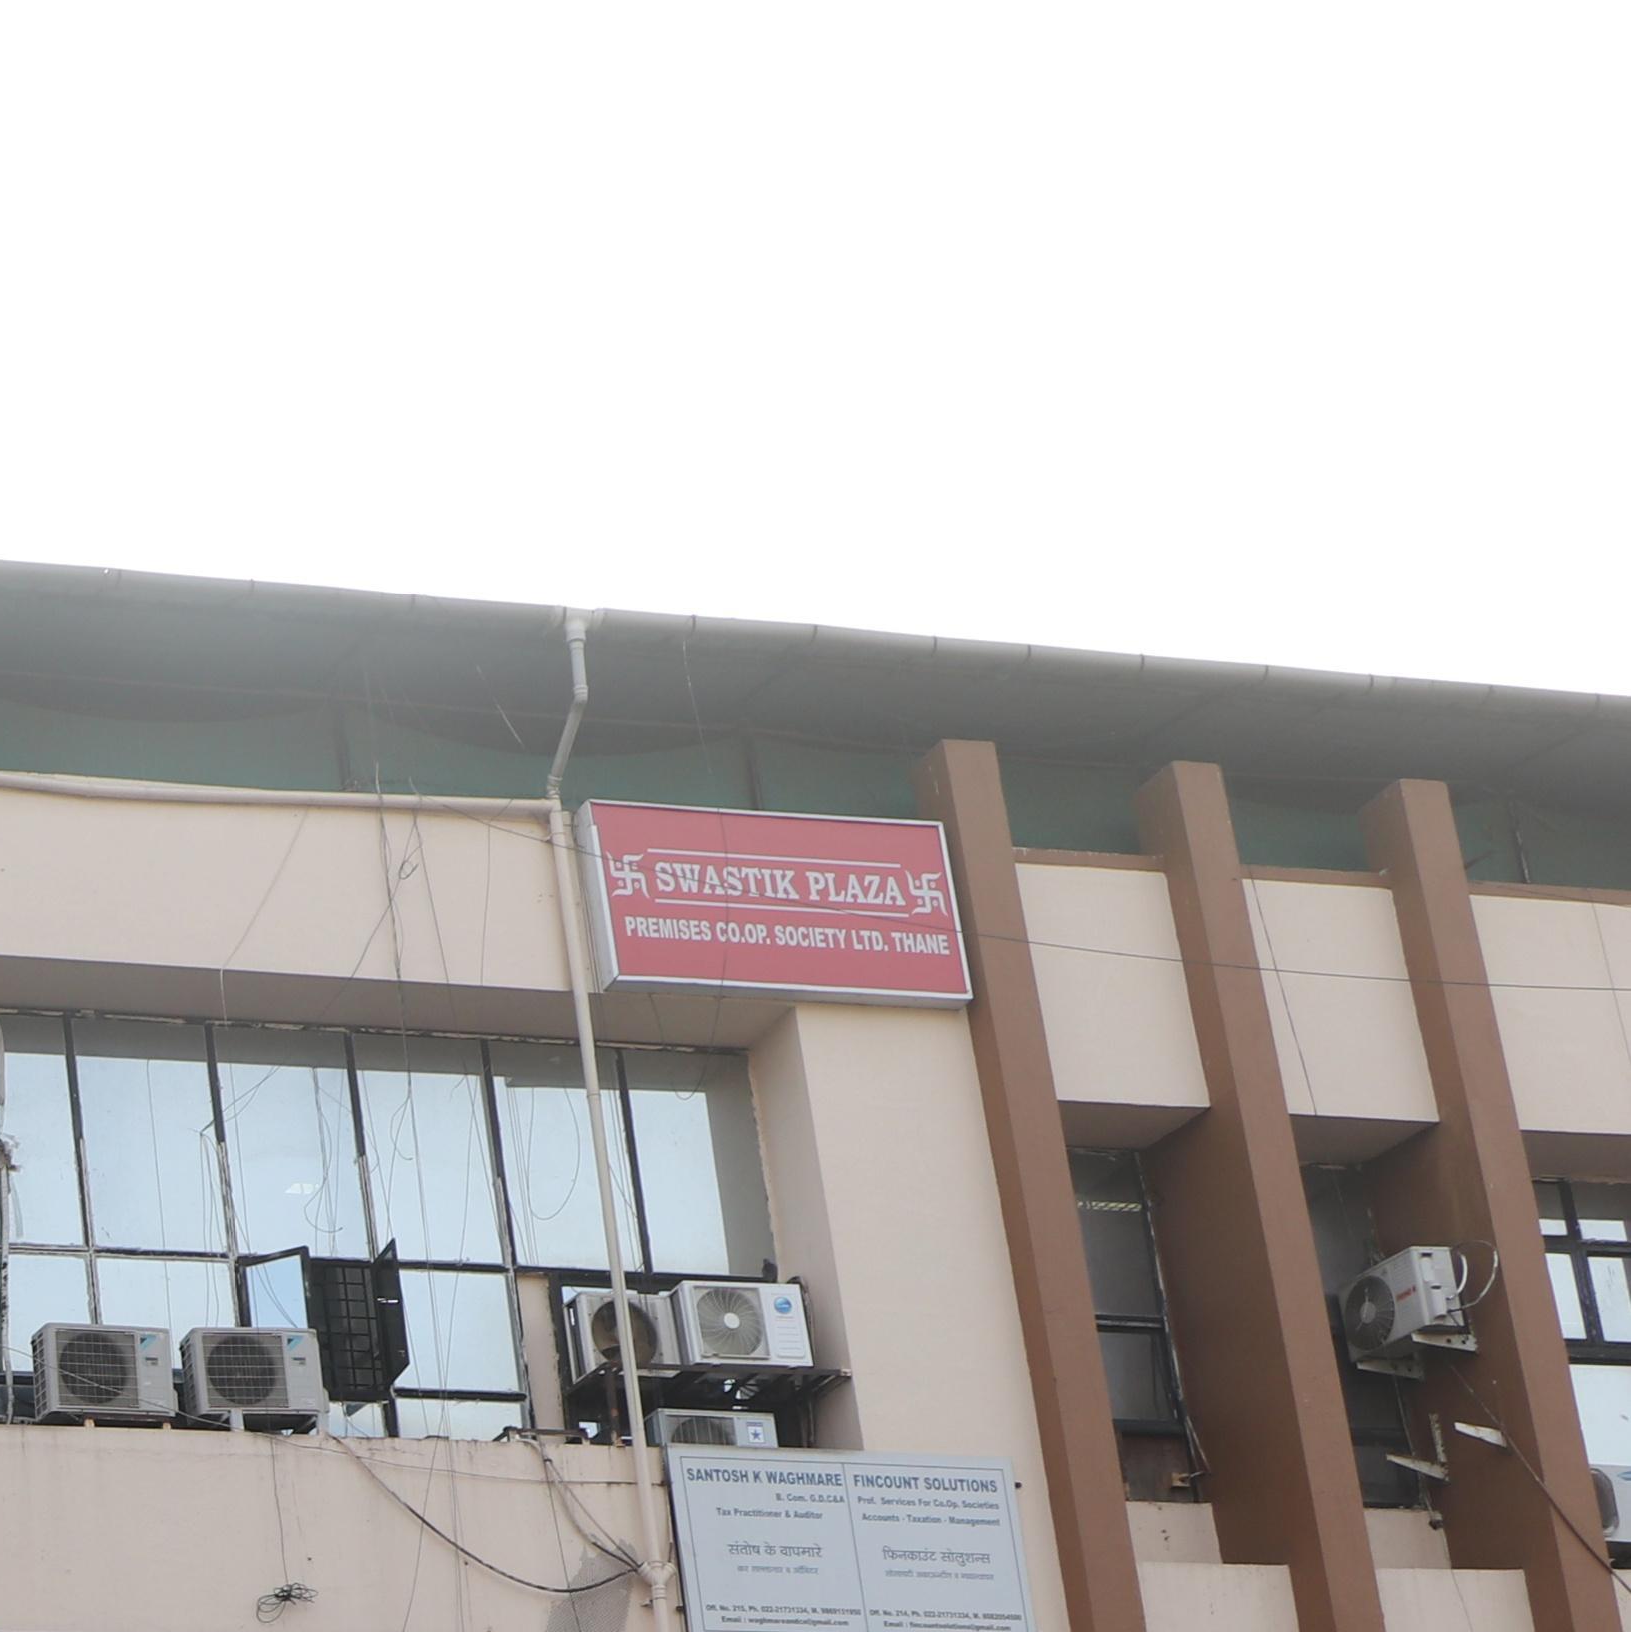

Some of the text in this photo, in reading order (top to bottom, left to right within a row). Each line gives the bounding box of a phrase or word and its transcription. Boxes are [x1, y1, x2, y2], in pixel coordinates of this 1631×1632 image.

[655, 861, 906, 905] SWASTIK PLAZA
[624, 916, 711, 941] PREMISES
[775, 925, 846, 948] SOCIETY
[852, 931, 888, 951] LTD.
[891, 933, 950, 955] THANE
[687, 1468, 843, 1486] SANTOSH K WAGHMARE
[853, 1474, 998, 1492] FINCOUNT SOLUTIONS
